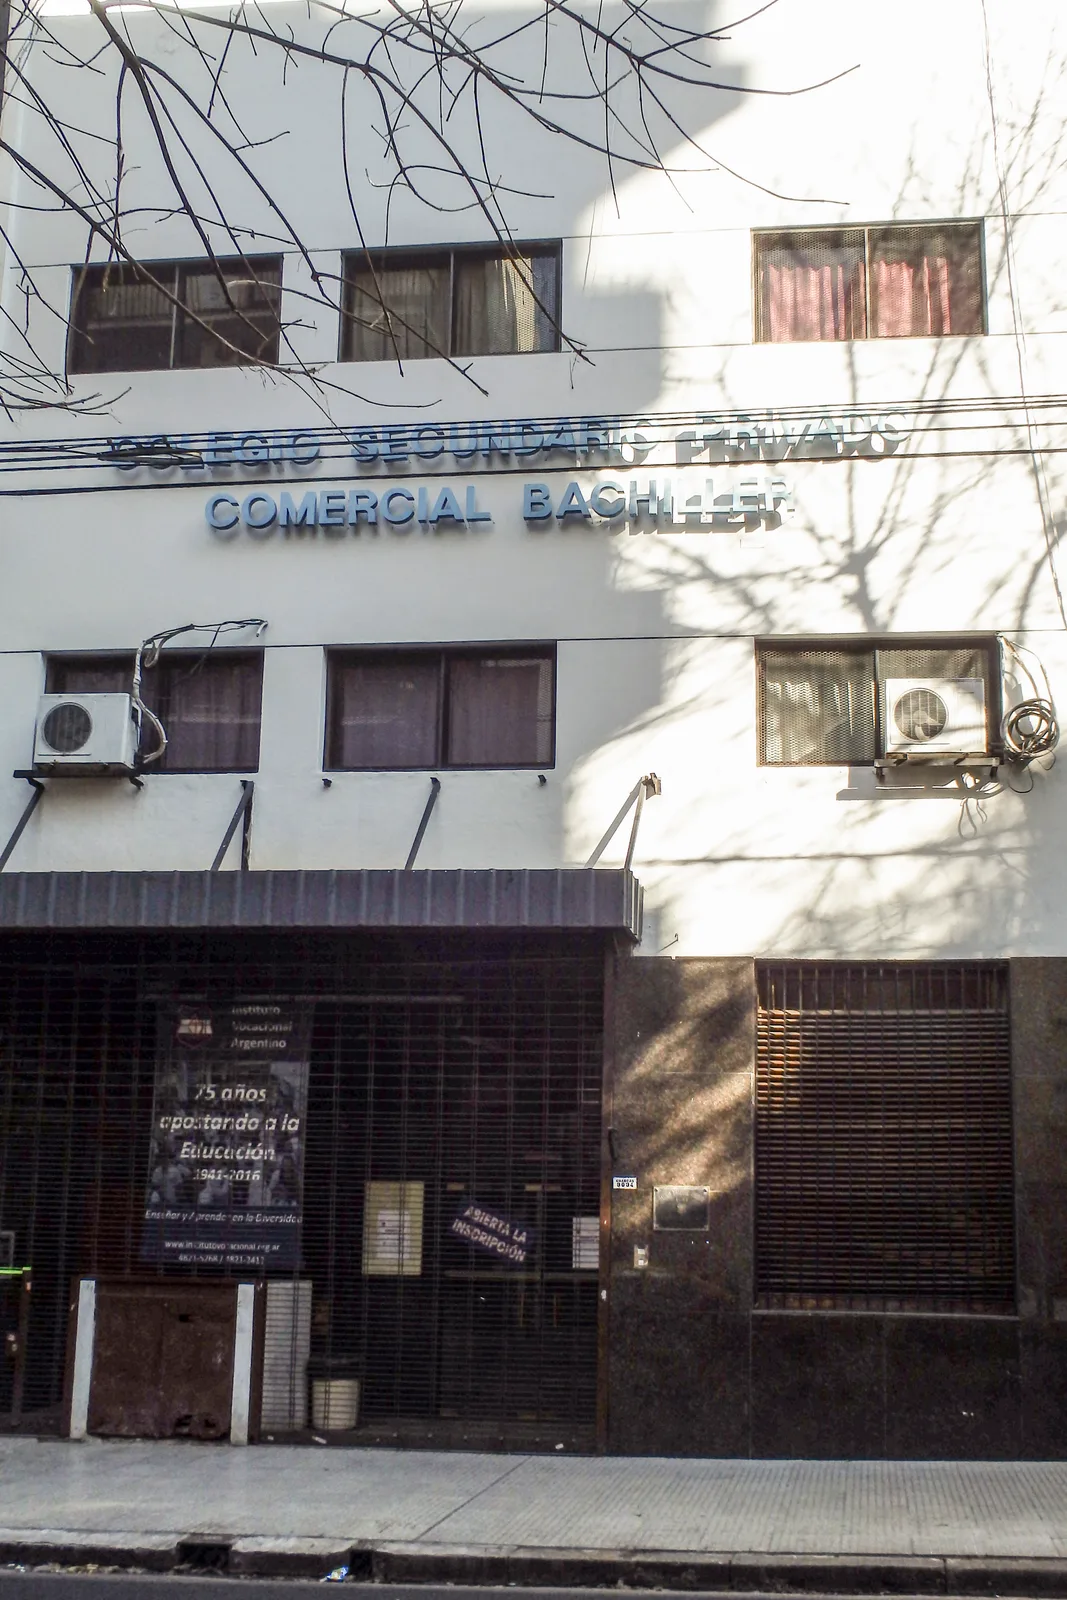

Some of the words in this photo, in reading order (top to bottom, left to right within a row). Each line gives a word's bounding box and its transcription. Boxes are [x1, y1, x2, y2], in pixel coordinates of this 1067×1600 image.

[350, 418, 658, 464] SECUNDARIO
[695, 407, 915, 450] PRIVADO
[205, 485, 492, 531] COMERCIAL
[523, 476, 796, 523] BACHILLER
[230, 1037, 287, 1050] Argentino
[194, 1083, 216, 1100] 75
[221, 1083, 267, 1101] años
[159, 1113, 260, 1133] apostando
[265, 1117, 276, 1131] a
[281, 1113, 300, 1132] la
[180, 1141, 276, 1161] Educación
[232, 1213, 244, 1222] en
[245, 1212, 254, 1222] la
[463, 1205, 511, 1237] ABIERTA
[512, 1228, 528, 1244] LA
[451, 1218, 528, 1263] INSCRIPCIÓN
